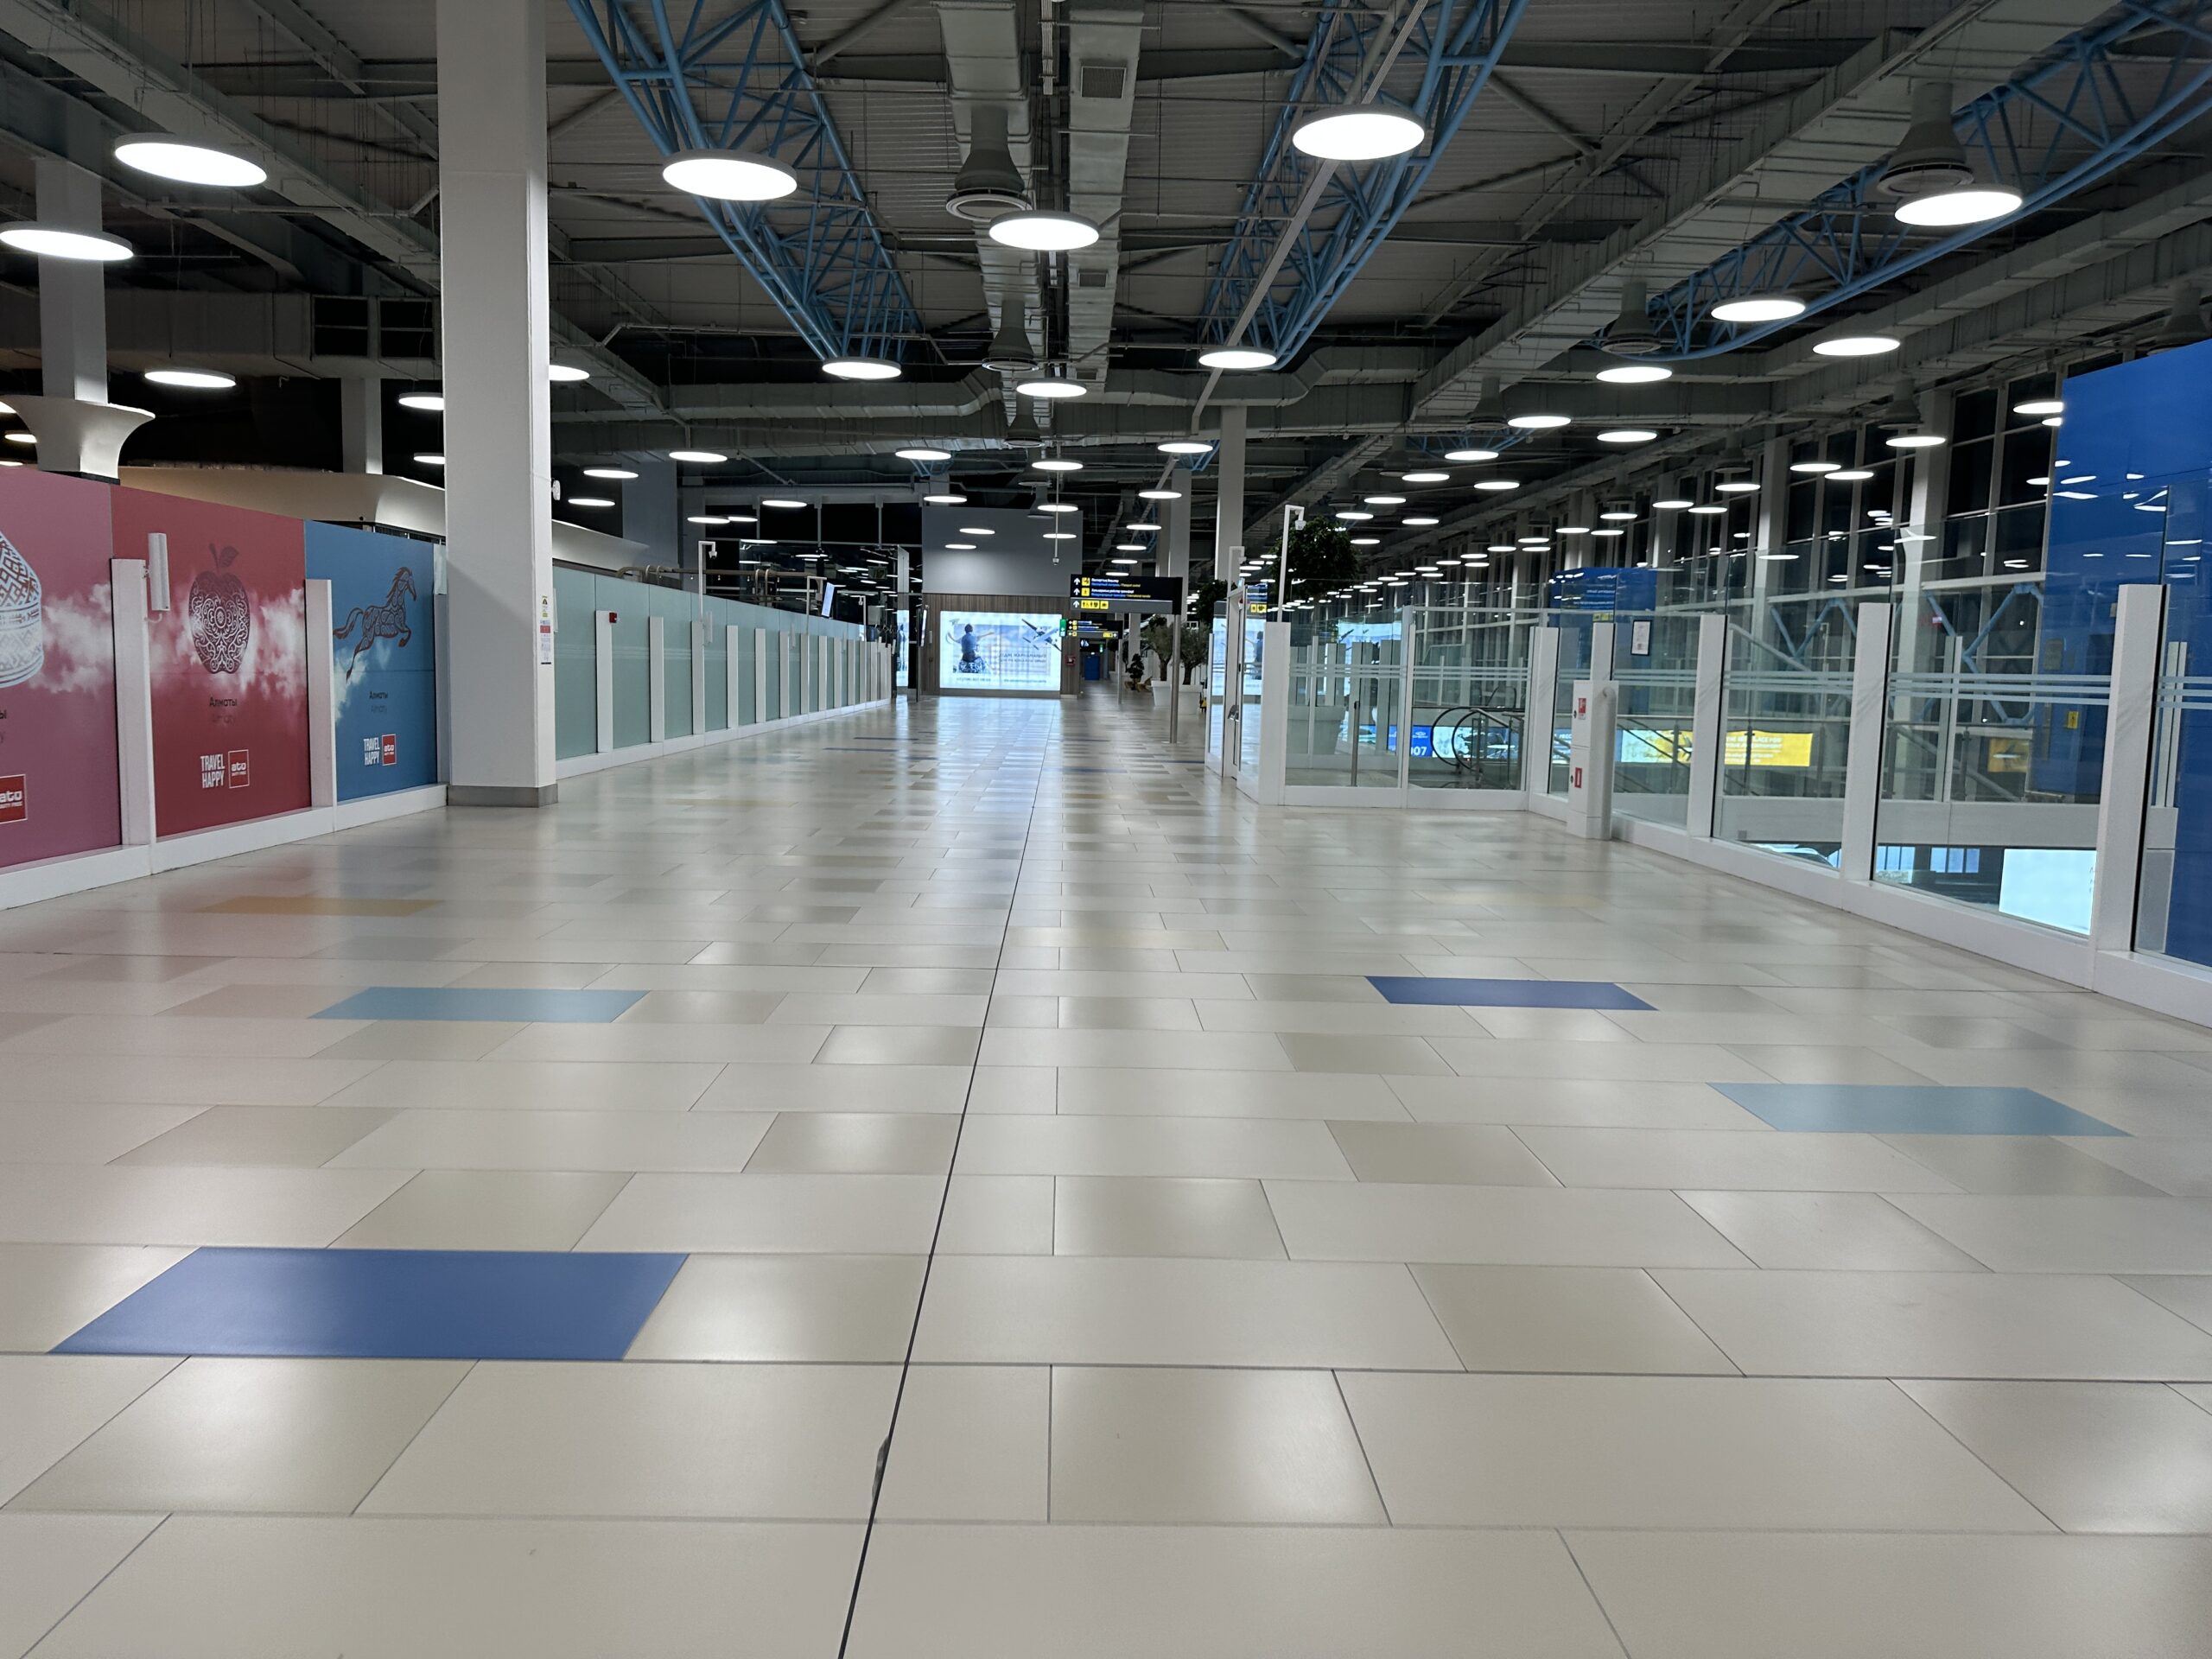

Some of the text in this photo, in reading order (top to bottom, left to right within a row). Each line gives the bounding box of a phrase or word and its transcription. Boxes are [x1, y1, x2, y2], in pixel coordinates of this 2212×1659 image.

[209, 696, 238, 707] Алматы
[363, 737, 380, 752] TRAVEL
[200, 753, 226, 772] TRAVEL
[365, 751, 380, 766] HAPPY
[231, 762, 246, 772] ato
[202, 771, 225, 788] HAPPY
